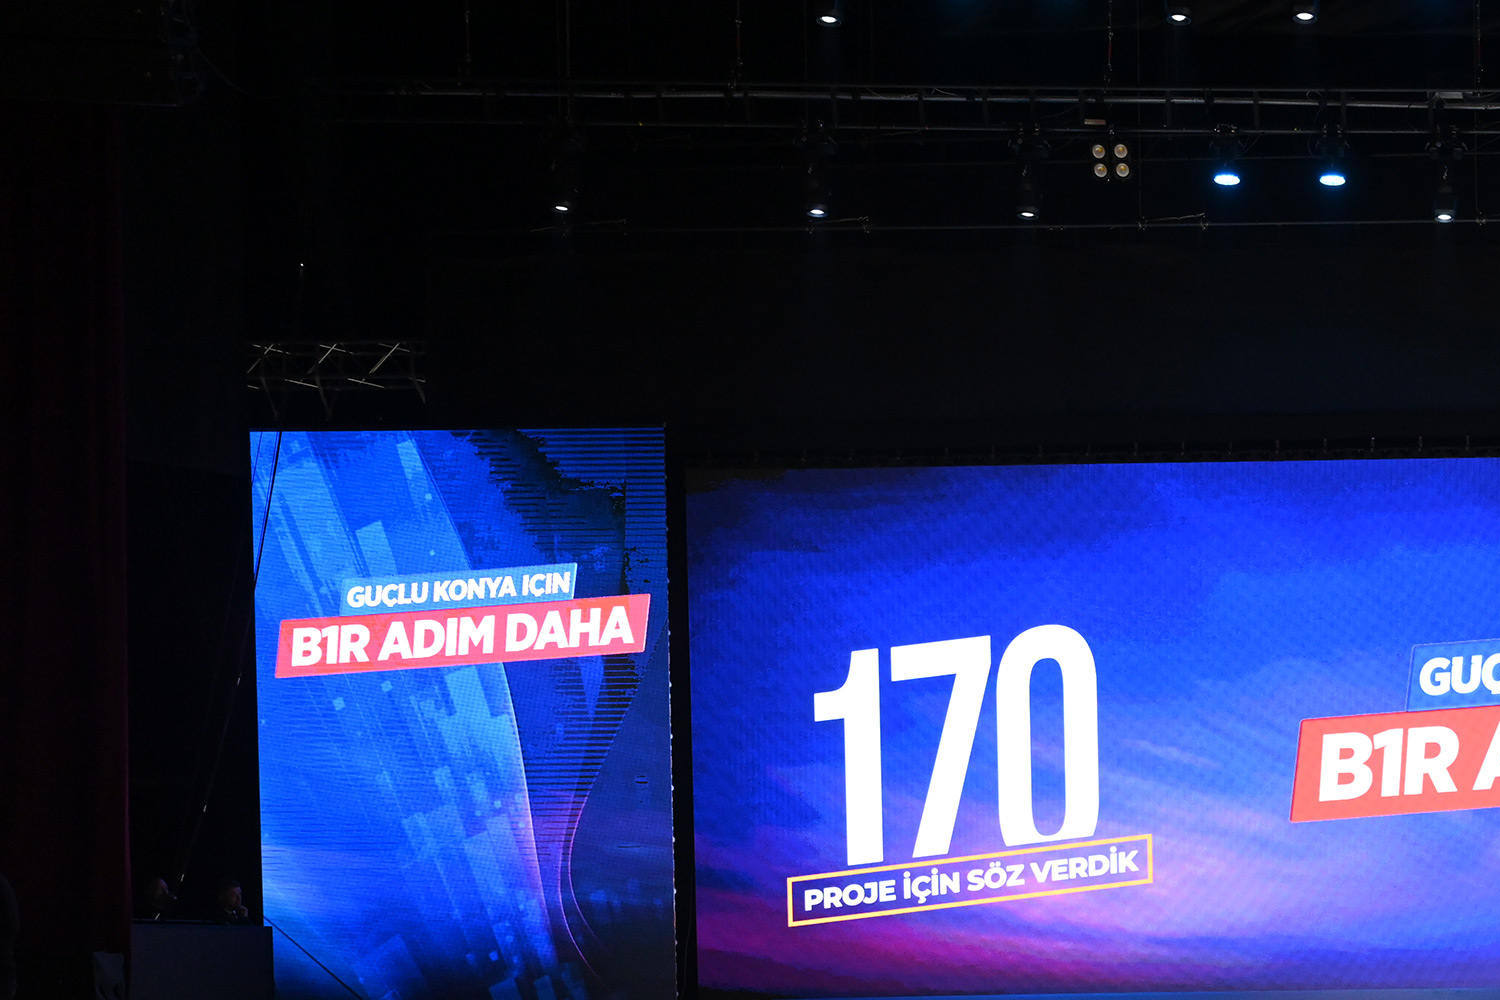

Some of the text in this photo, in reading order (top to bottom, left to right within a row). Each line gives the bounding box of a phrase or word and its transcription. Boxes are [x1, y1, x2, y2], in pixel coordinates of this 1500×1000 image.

[433, 575, 517, 602] KONYA
[291, 605, 635, 667] B1R ADIM DAHA
[813, 624, 1100, 866] 170
[1318, 726, 1460, 802] B1R
[804, 845, 1140, 911] PROJE İÇİN SÖZ VERDİK
